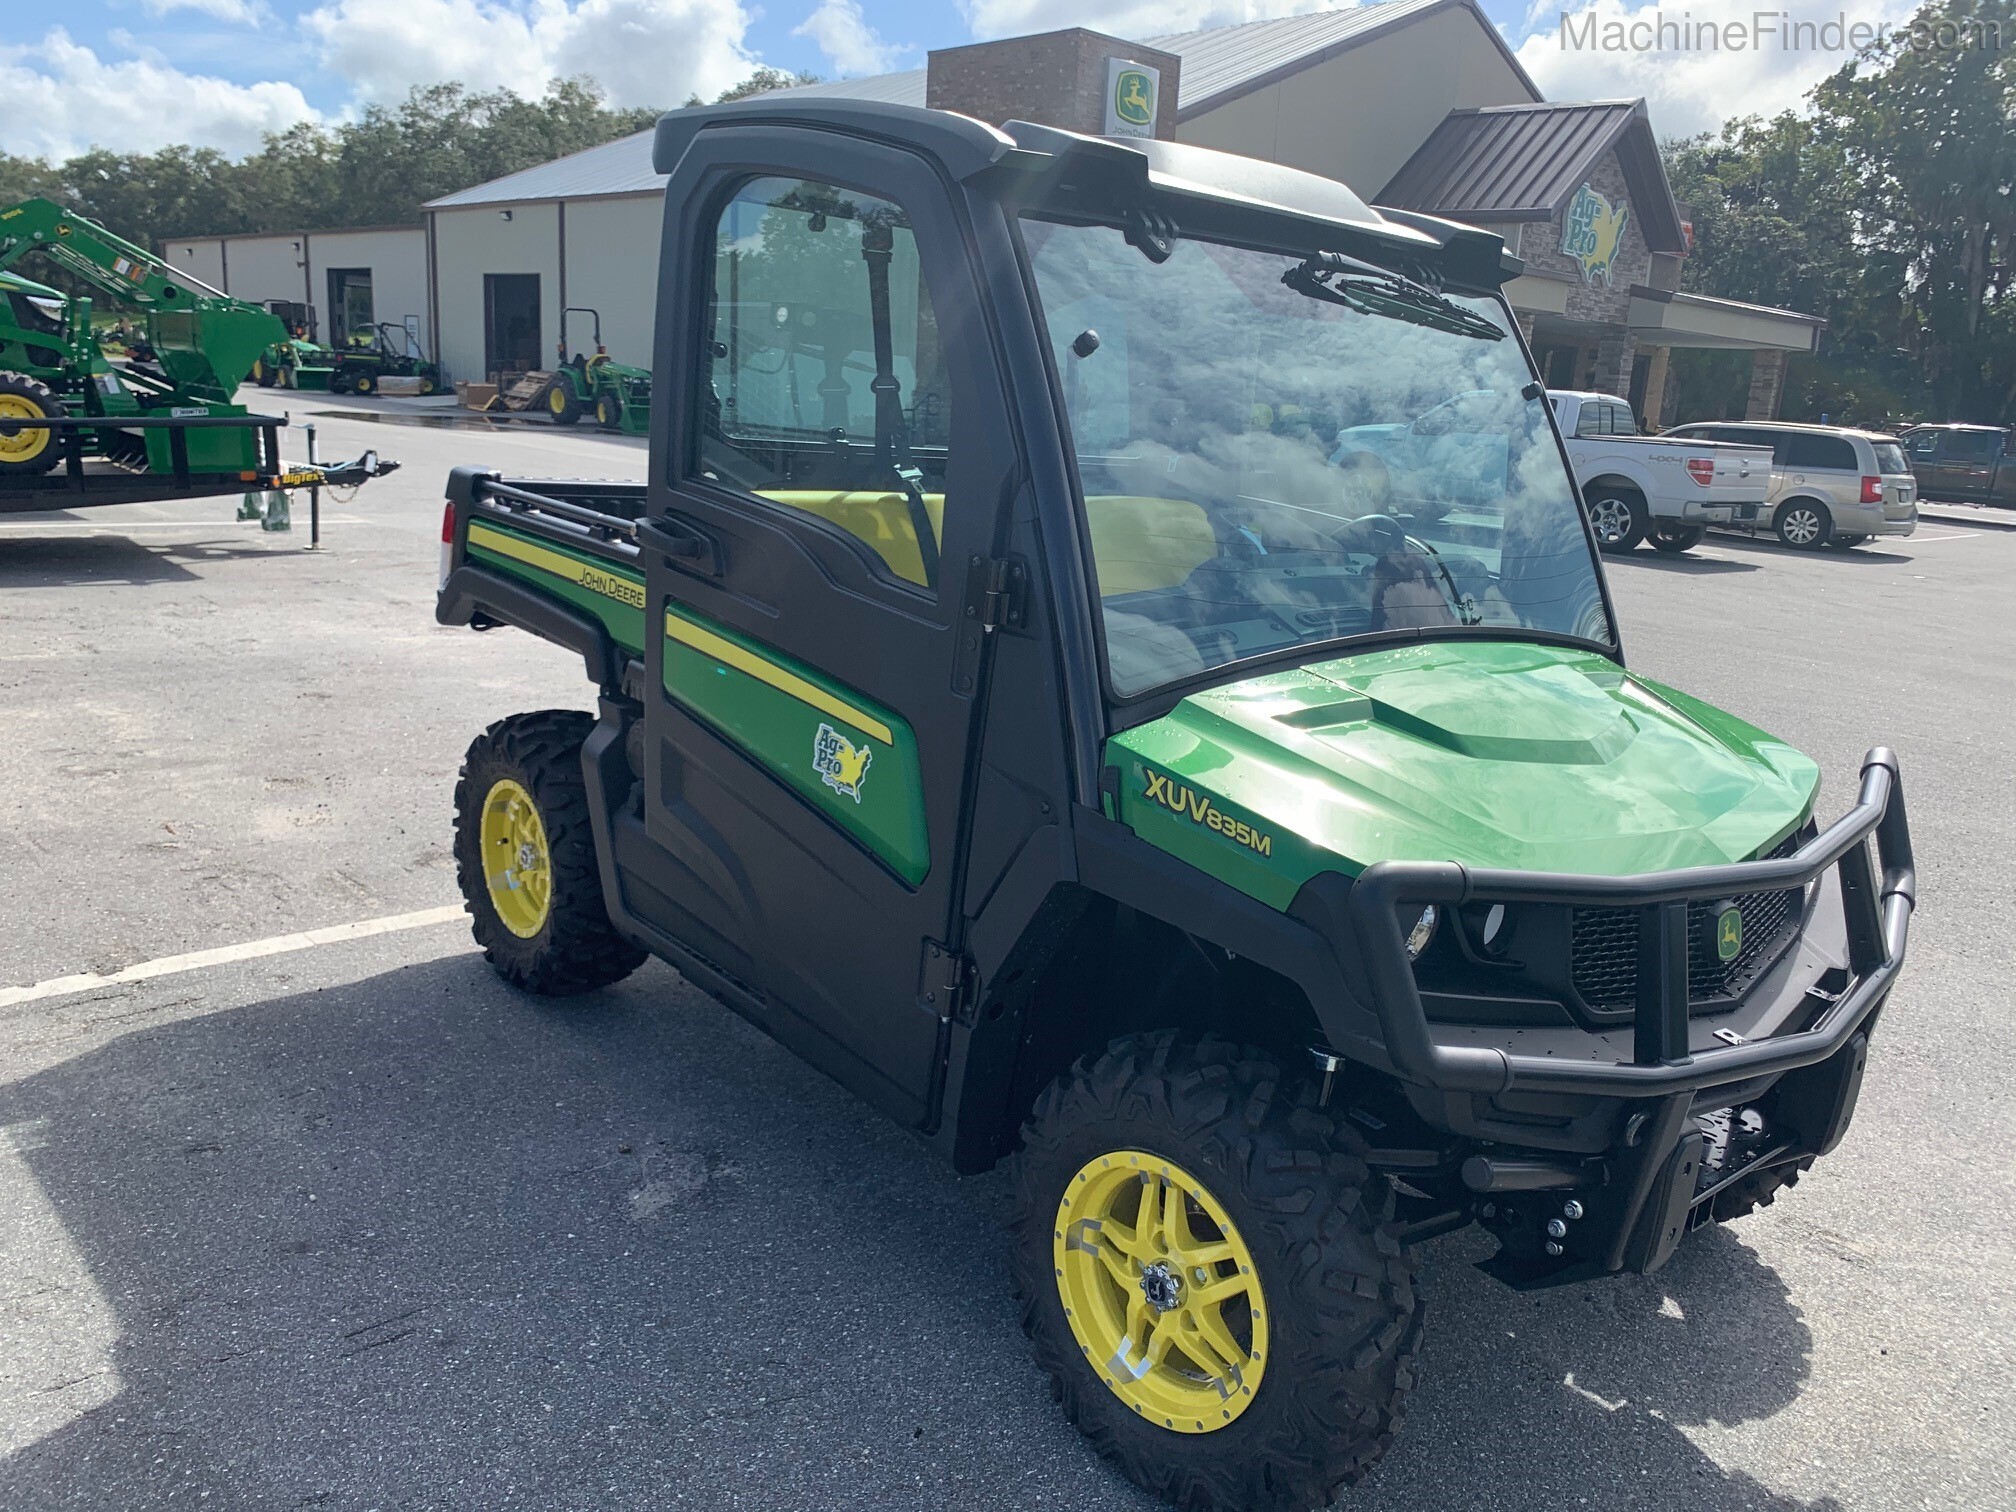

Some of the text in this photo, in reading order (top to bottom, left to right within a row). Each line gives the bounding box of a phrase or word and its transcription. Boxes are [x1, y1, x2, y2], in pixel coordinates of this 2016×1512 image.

[1113, 126, 1133, 136] JOHN
[1571, 186, 1602, 228] Ag-
[1565, 219, 1597, 257] Pro
[579, 567, 644, 606] JOHN DEERE
[818, 728, 845, 756] Ag-
[816, 748, 842, 775] Pro
